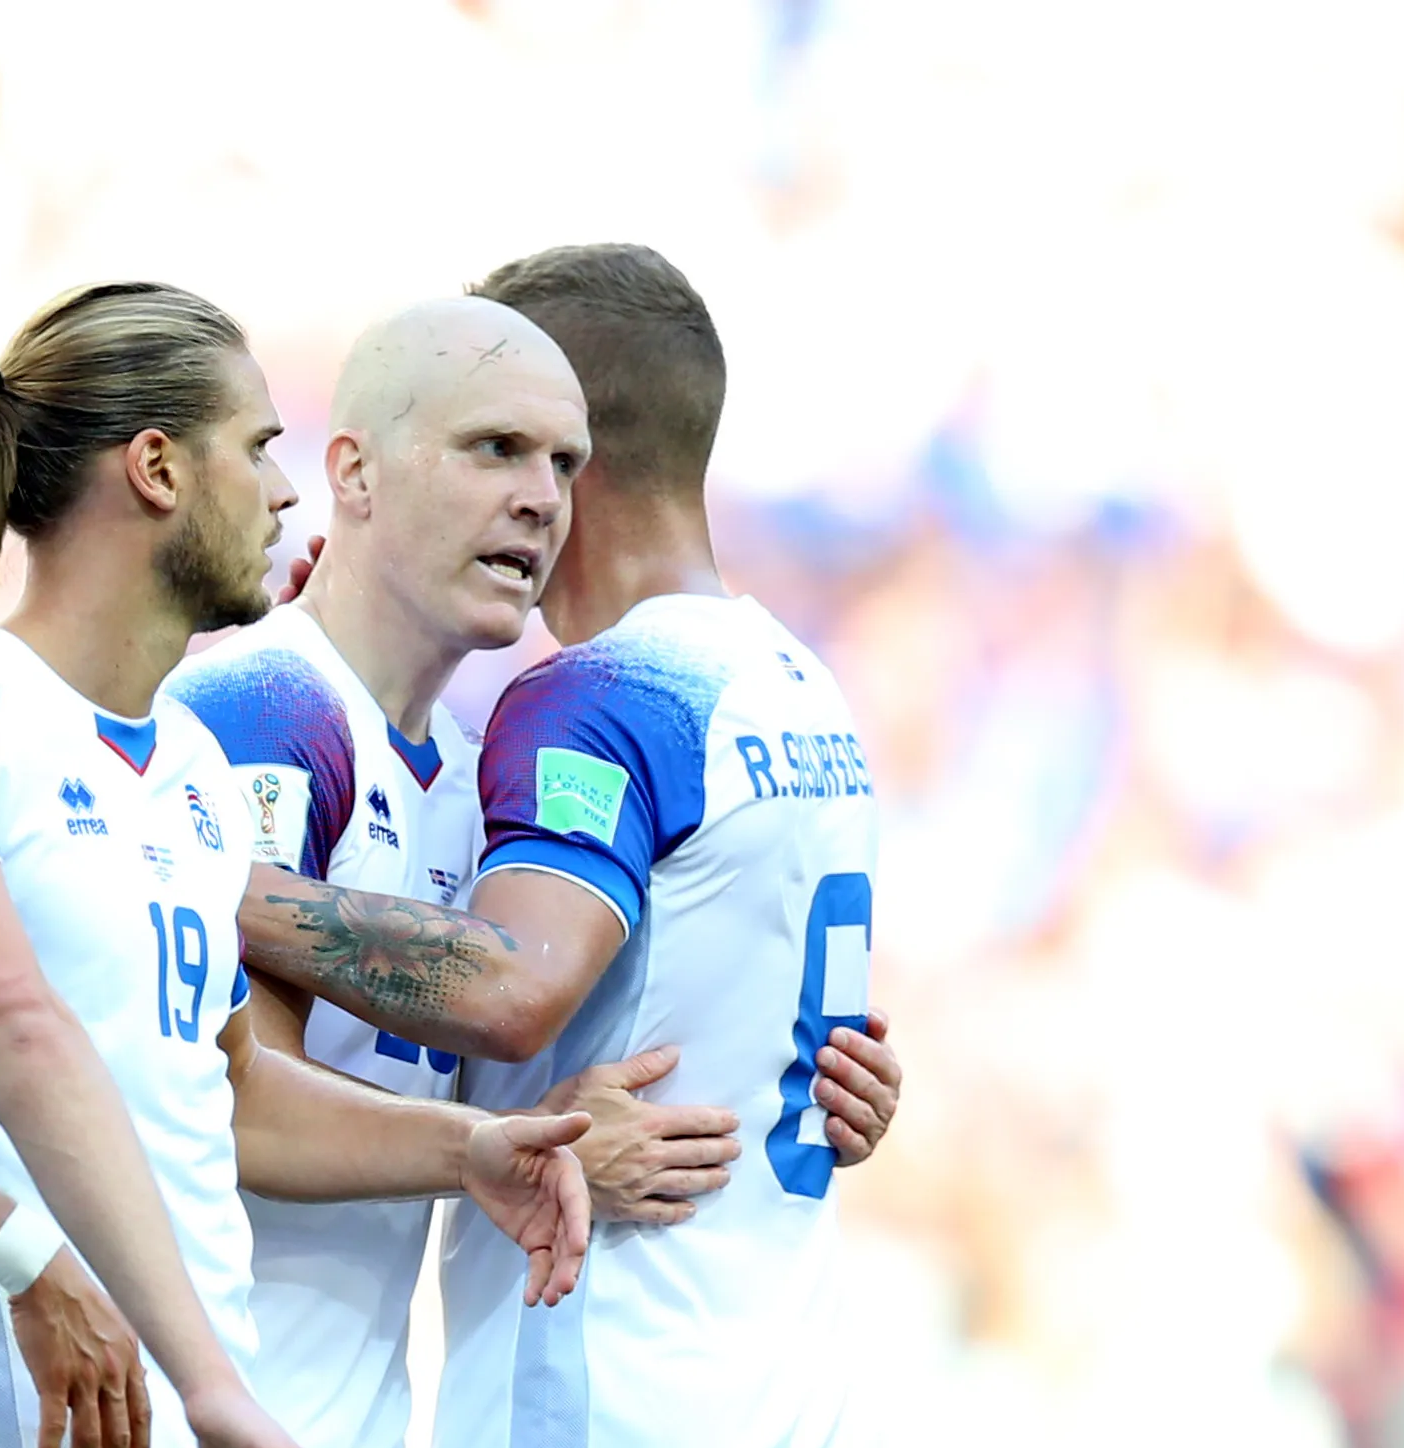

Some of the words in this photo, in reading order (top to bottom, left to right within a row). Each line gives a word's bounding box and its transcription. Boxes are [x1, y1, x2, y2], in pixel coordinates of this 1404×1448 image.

[66, 817, 109, 836] errea
[368, 821, 400, 850] errea
[148, 901, 209, 1044] 19
